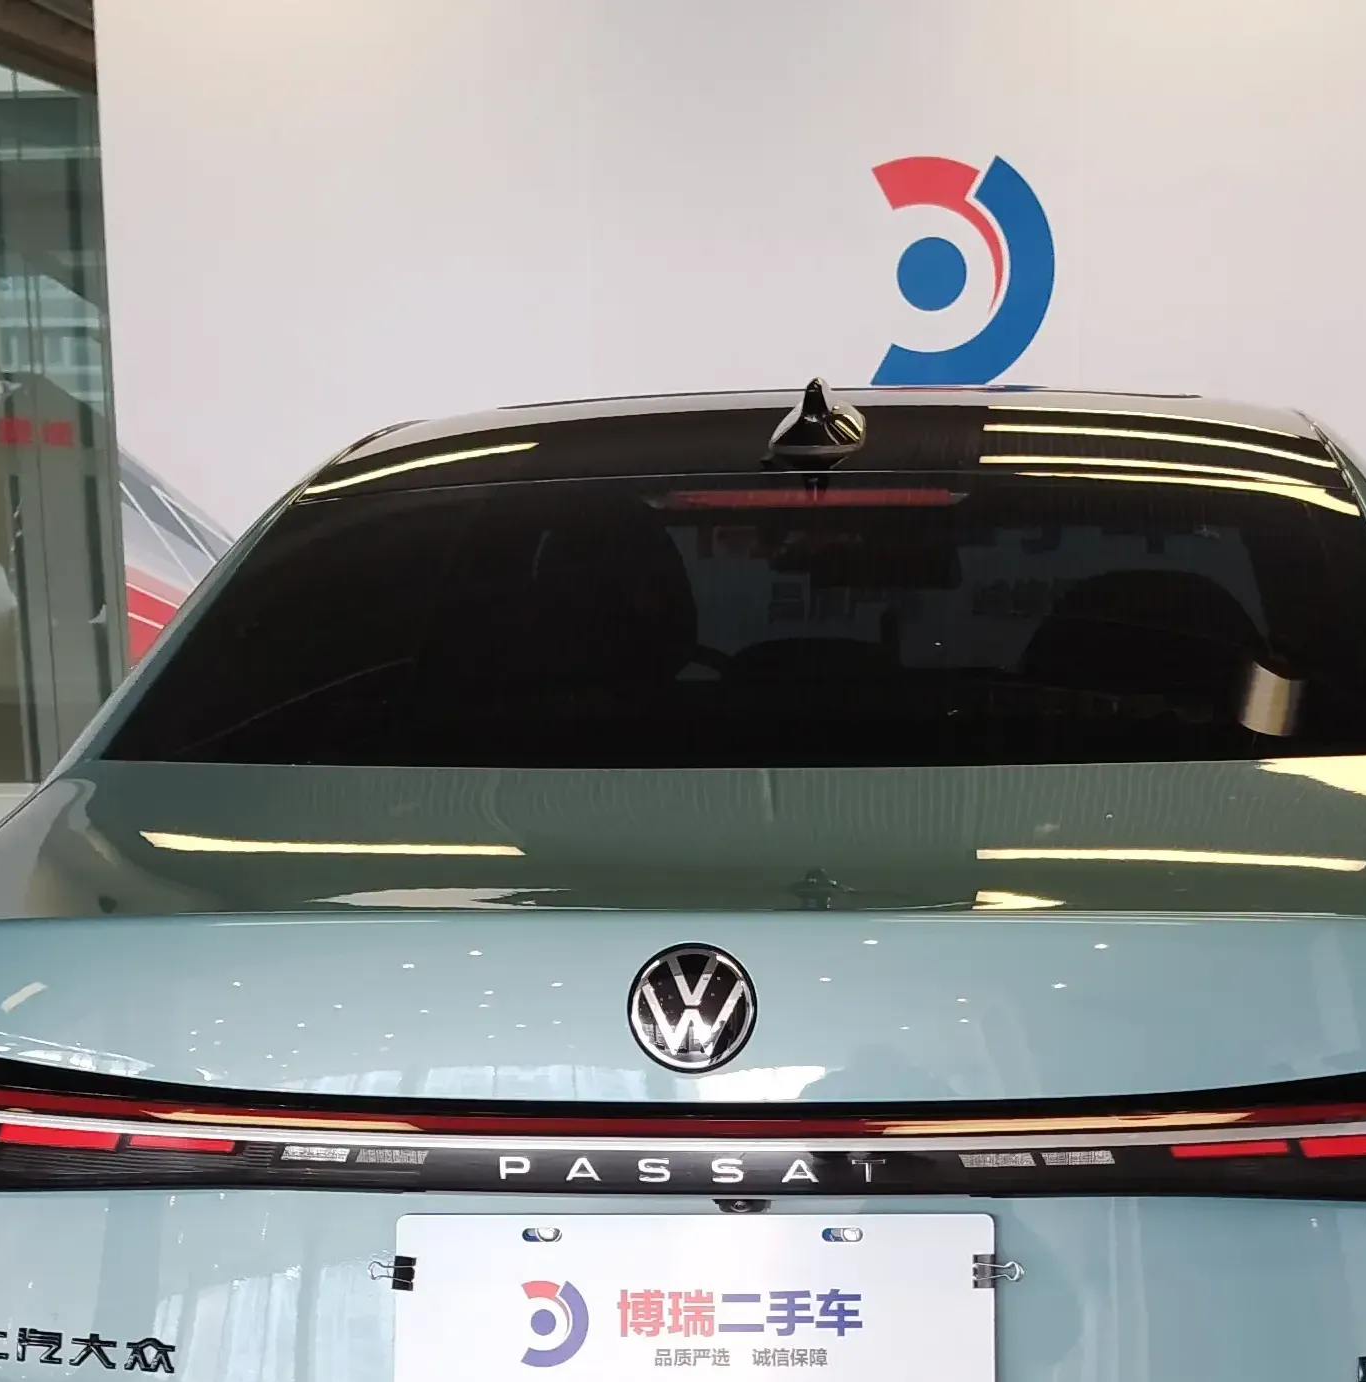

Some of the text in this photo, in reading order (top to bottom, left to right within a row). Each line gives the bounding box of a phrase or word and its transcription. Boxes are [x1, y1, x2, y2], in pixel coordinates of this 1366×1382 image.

[498, 1156, 887, 1184] PASSAT
[617, 1288, 864, 1338] 博瑞二手车
[654, 1348, 828, 1368] 品质严选 诚信保障
